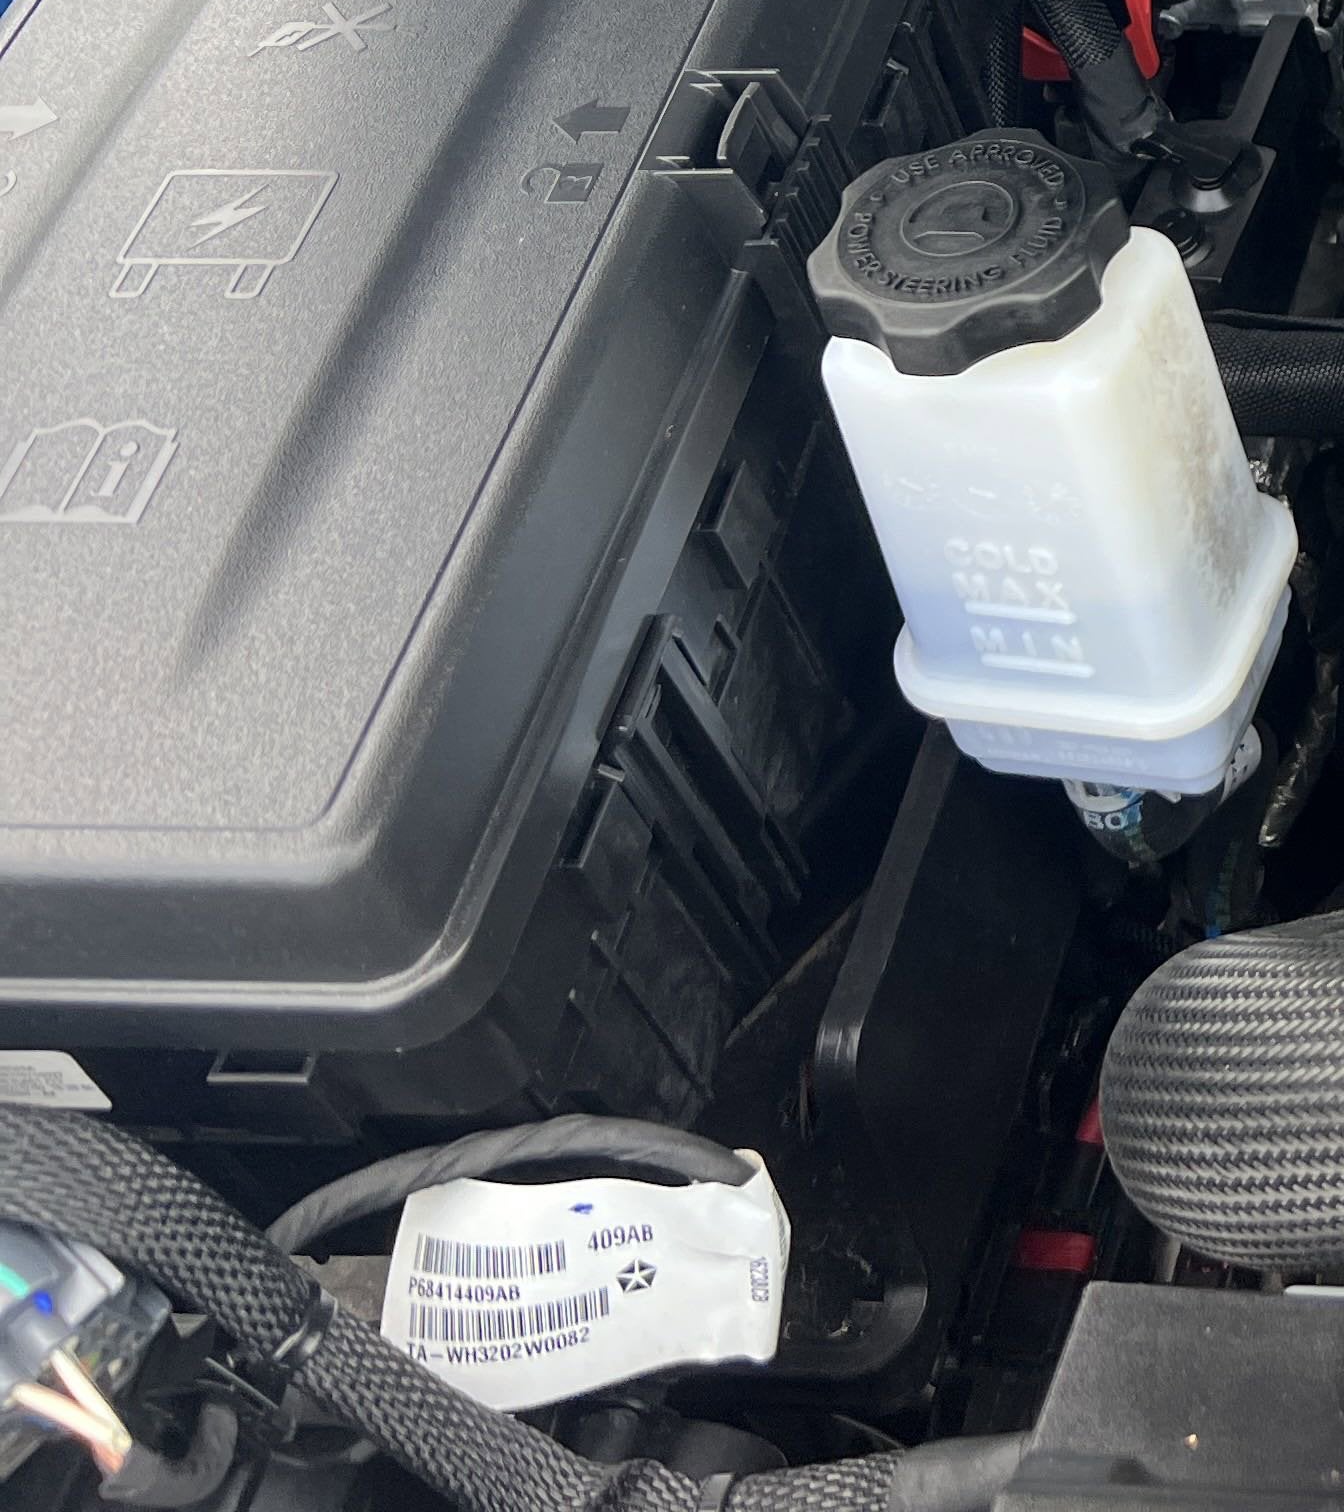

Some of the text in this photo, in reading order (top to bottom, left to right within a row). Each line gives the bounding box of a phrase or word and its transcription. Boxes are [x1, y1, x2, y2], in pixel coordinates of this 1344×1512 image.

[890, 143, 1066, 189] USE APPROVED
[847, 211, 1064, 296] POWER STEERING FLUID
[943, 537, 1060, 576] COLD
[951, 571, 1071, 612] MAX
[969, 625, 1085, 661] MIN
[587, 1223, 655, 1253] 409AB
[407, 1276, 522, 1303] P68414409AB
[406, 1326, 591, 1365] TA-WH3202W0082
